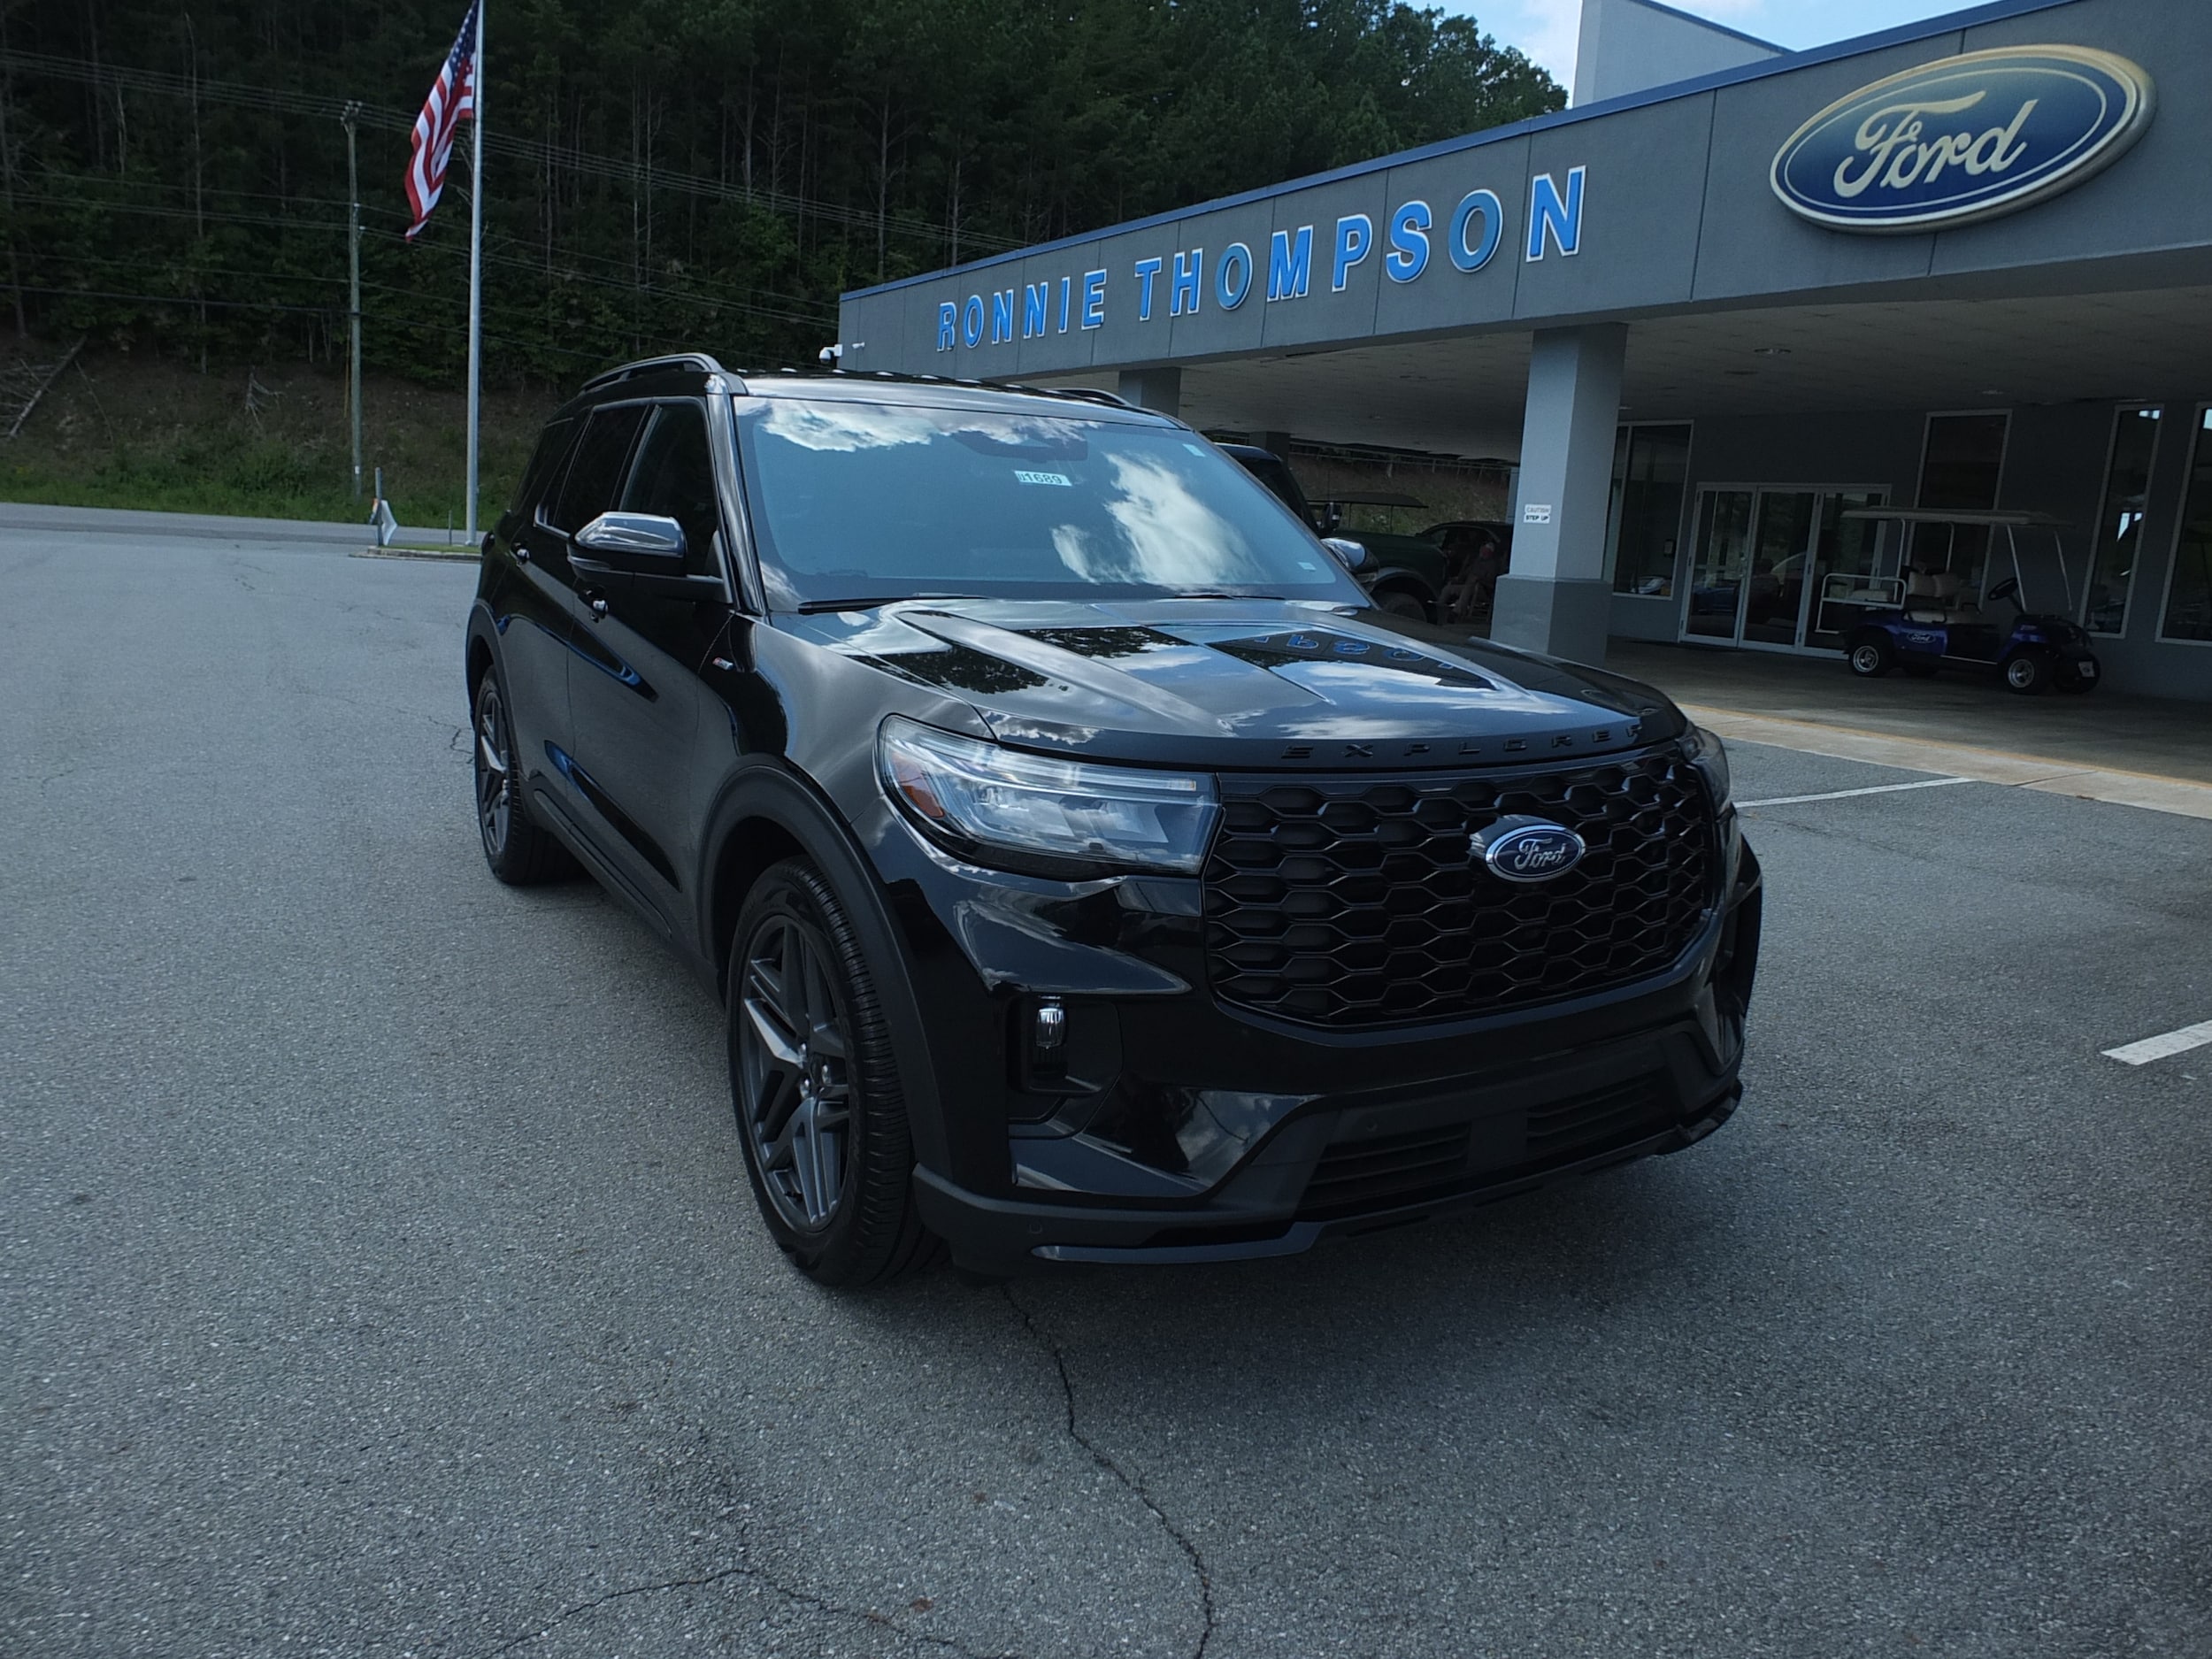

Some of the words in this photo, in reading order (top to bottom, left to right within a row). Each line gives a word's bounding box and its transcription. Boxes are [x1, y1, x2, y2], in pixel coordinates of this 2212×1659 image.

[1833, 90, 2039, 198] Ford
[936, 268, 1108, 353] RONNIE
[1135, 165, 1587, 322] THOMPSON
[1514, 837, 1568, 870] Ford
